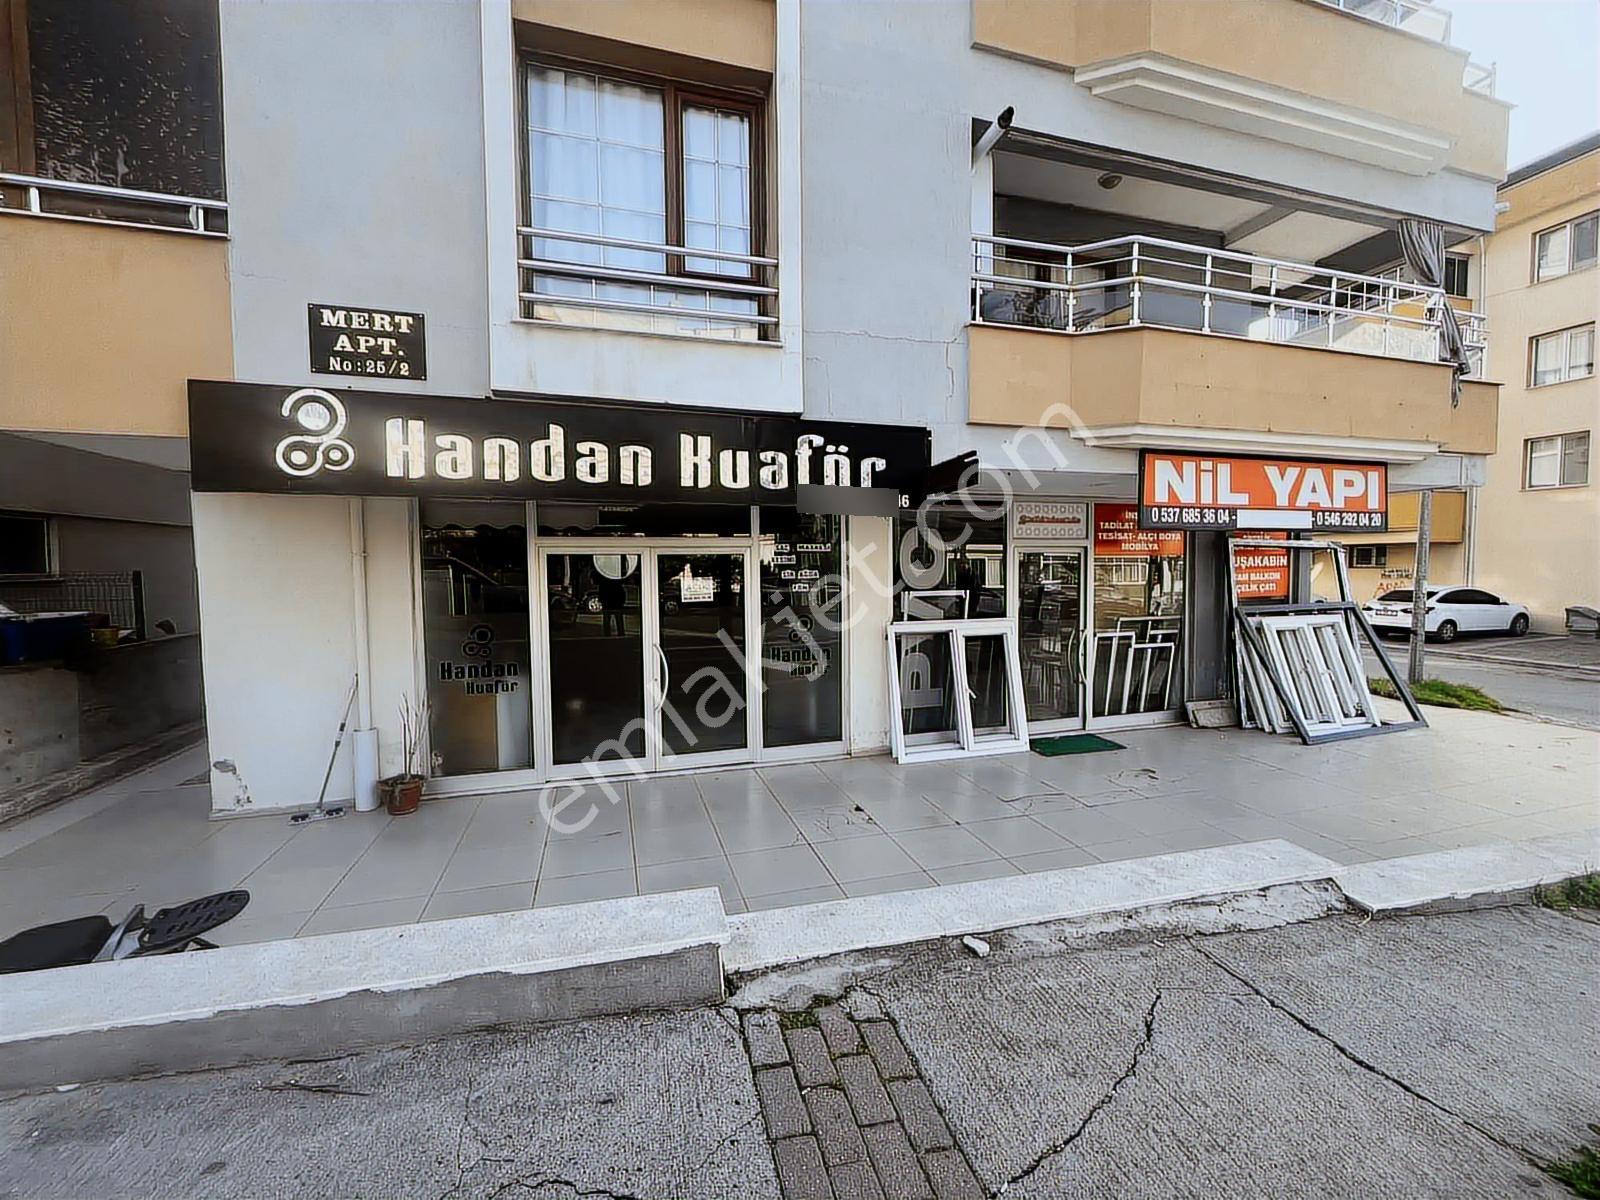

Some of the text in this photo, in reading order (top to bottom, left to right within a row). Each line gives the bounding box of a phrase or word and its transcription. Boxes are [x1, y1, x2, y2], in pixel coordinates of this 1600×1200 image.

[320, 308, 414, 333] MERT
[333, 334, 404, 356] APT.
[385, 417, 652, 487] Handan
[1264, 465, 1380, 510] YAPI
[1152, 508, 1158, 523] 0
[1161, 508, 1179, 523] 537
[1182, 508, 1201, 524] 685
[1203, 509, 1215, 524] 36
[1217, 510, 1230, 524] 04
[1317, 512, 1323, 526] 0
[1324, 512, 1341, 526] 546
[1342, 512, 1358, 526] 292
[1359, 512, 1370, 526] 04
[1371, 513, 1382, 527] 20
[1233, 555, 1288, 569] UŞAKABİN
[440, 660, 519, 681] Handan
